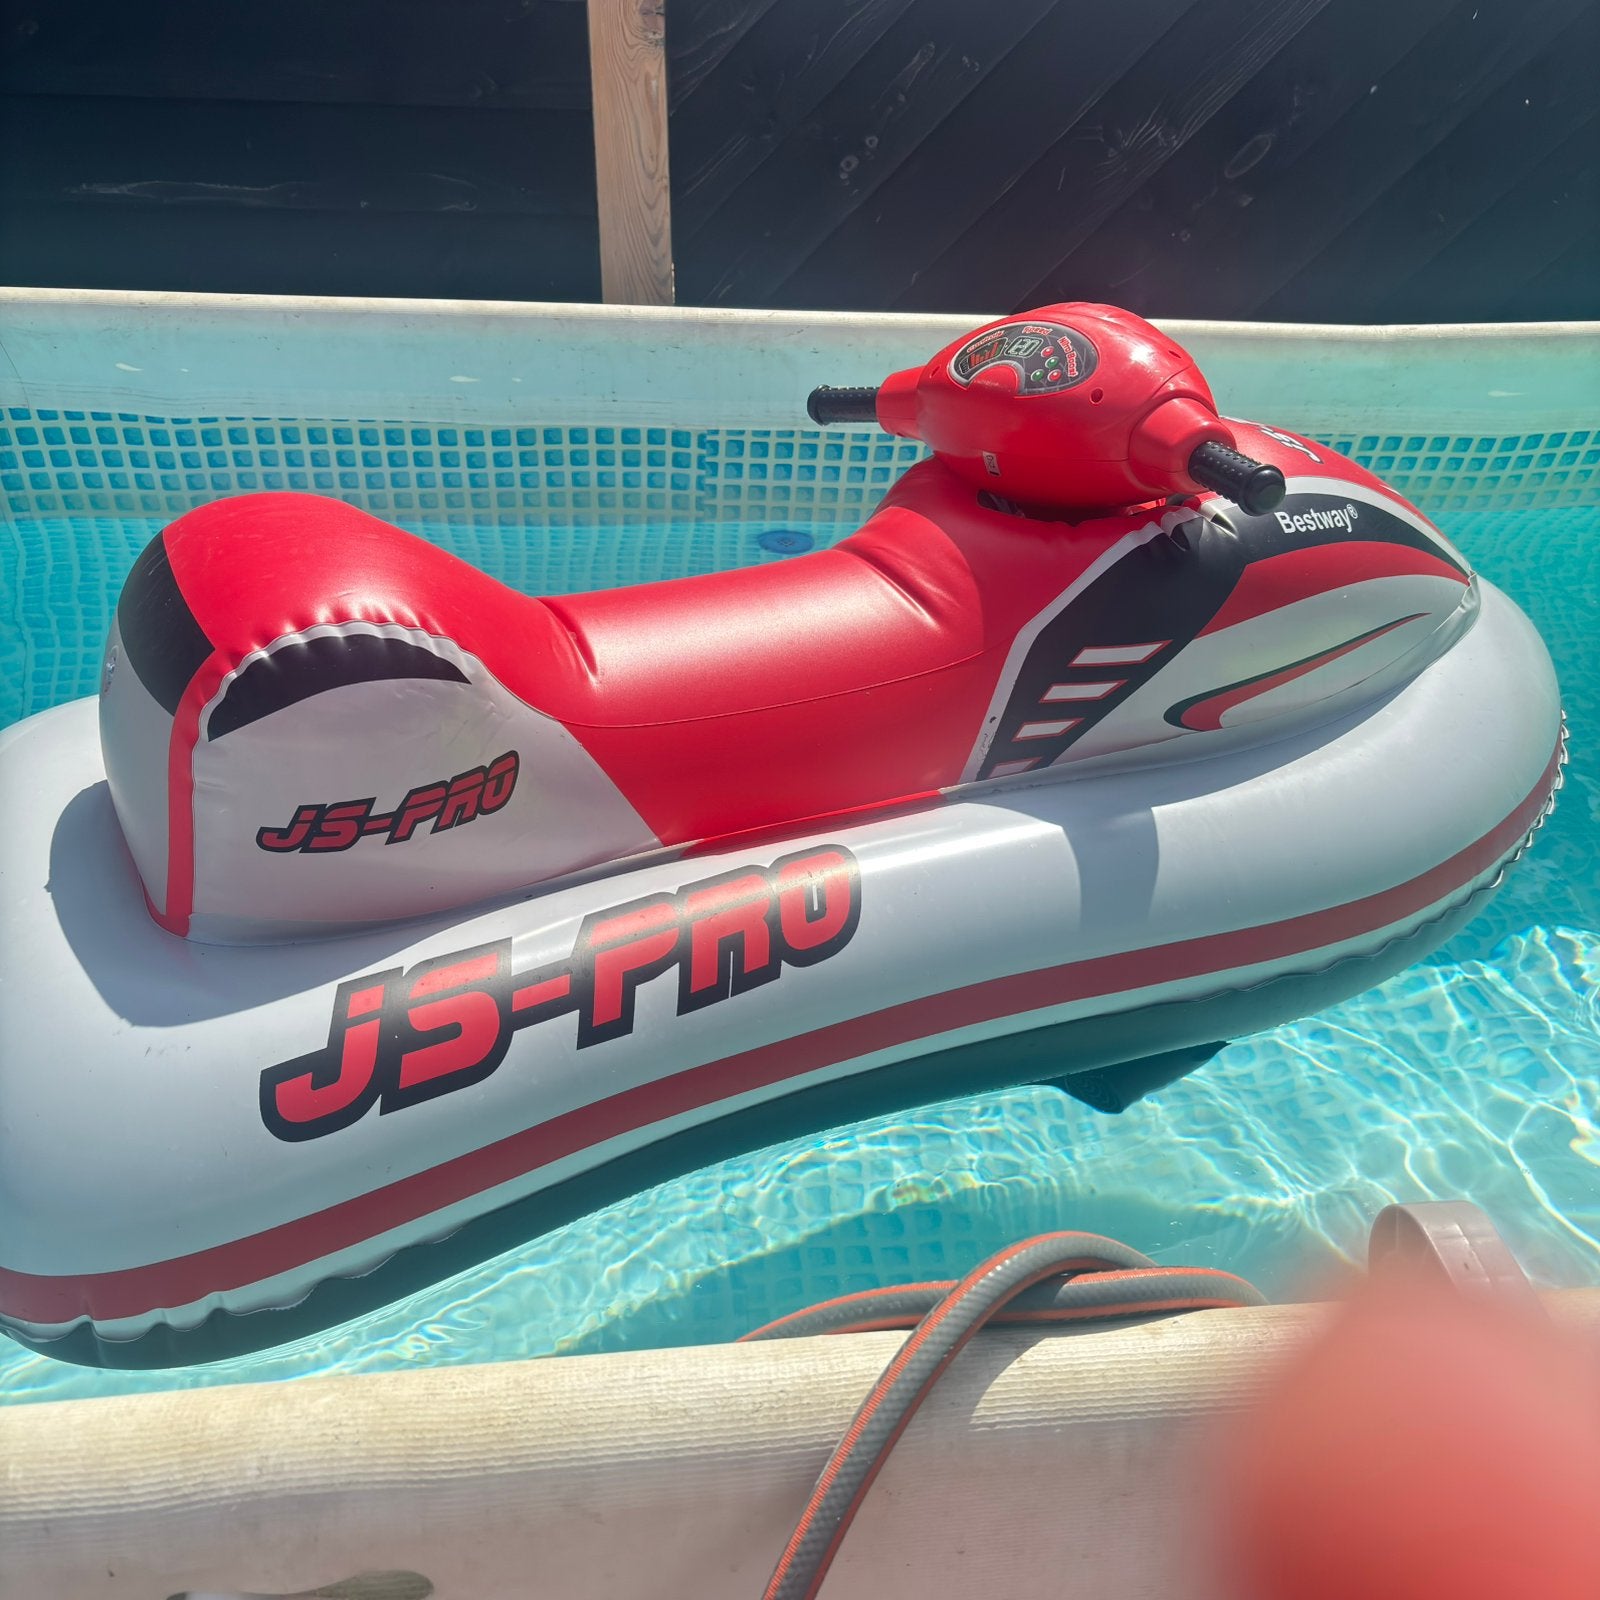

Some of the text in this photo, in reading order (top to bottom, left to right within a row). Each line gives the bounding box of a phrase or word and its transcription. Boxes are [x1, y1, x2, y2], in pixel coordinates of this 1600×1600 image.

[1066, 351, 1079, 377] Boost
[256, 750, 520, 853] JS-PRO
[259, 844, 862, 1142] JS-PRO
